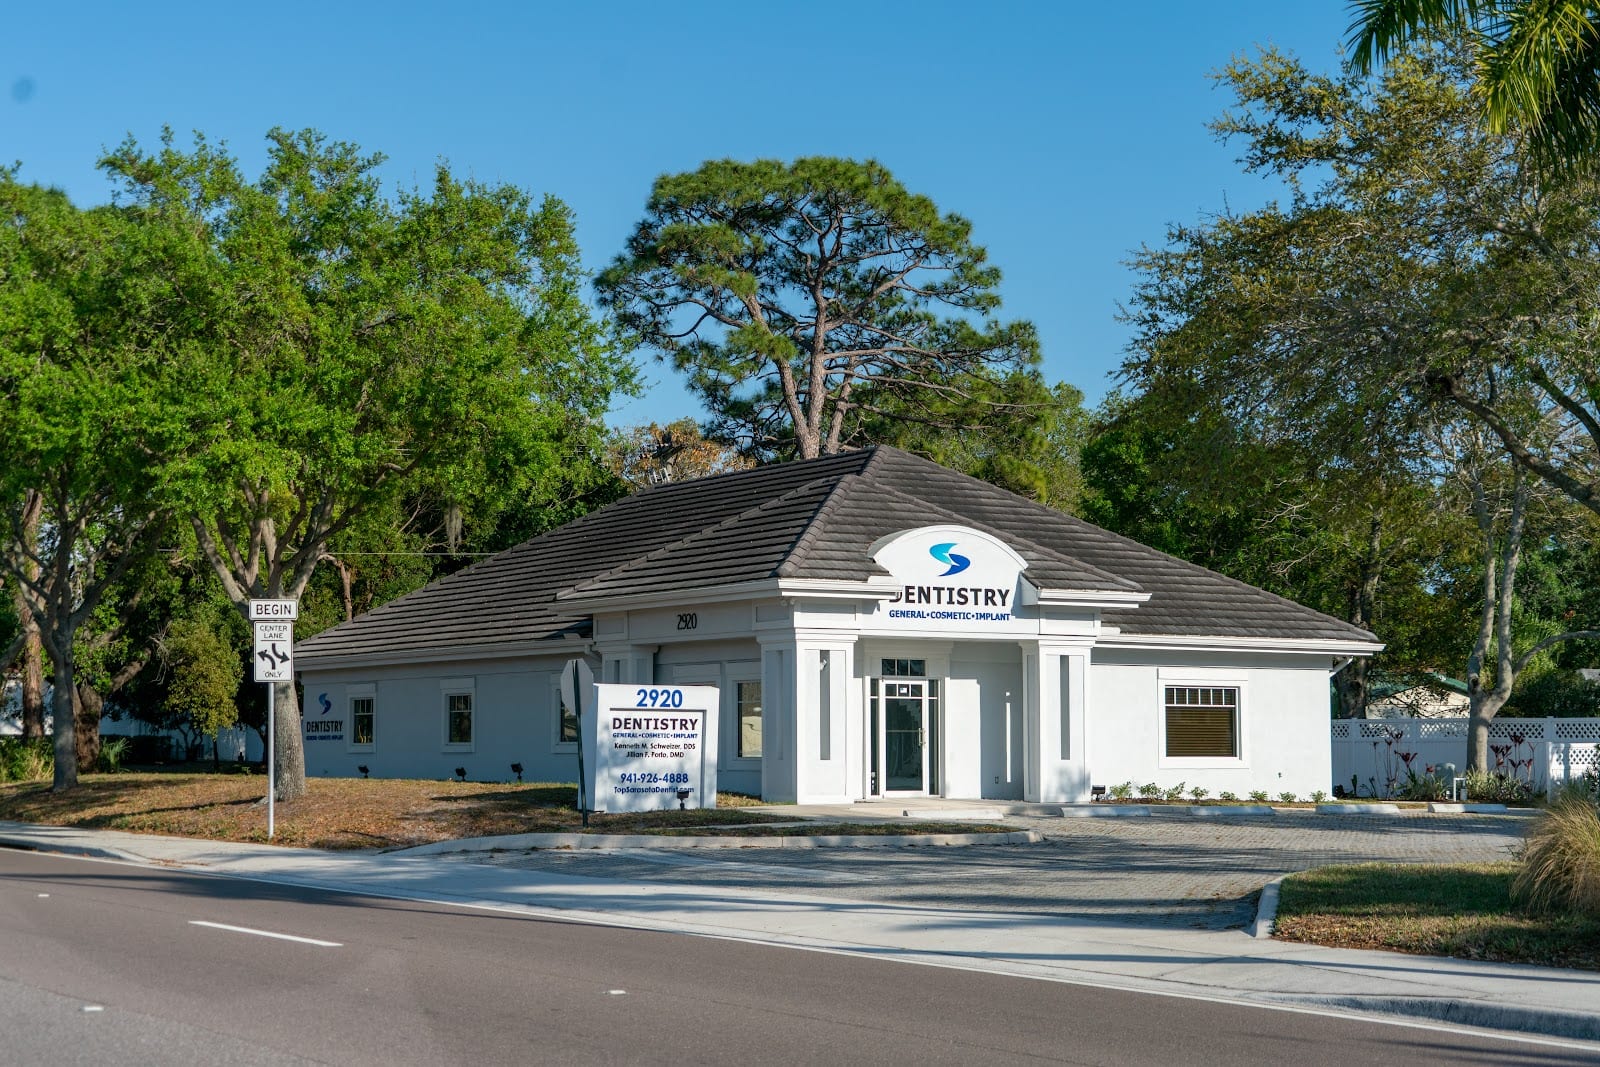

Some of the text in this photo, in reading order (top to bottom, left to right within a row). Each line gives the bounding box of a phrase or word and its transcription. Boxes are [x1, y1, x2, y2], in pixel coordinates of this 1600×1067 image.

[256, 604, 292, 615] BEGIN
[677, 613, 698, 630] 2920
[636, 689, 683, 708] 2920
[306, 720, 343, 733] DENTISTRY
[612, 717, 699, 731] DENTISTRY
[620, 773, 689, 784] 941-926-4888
